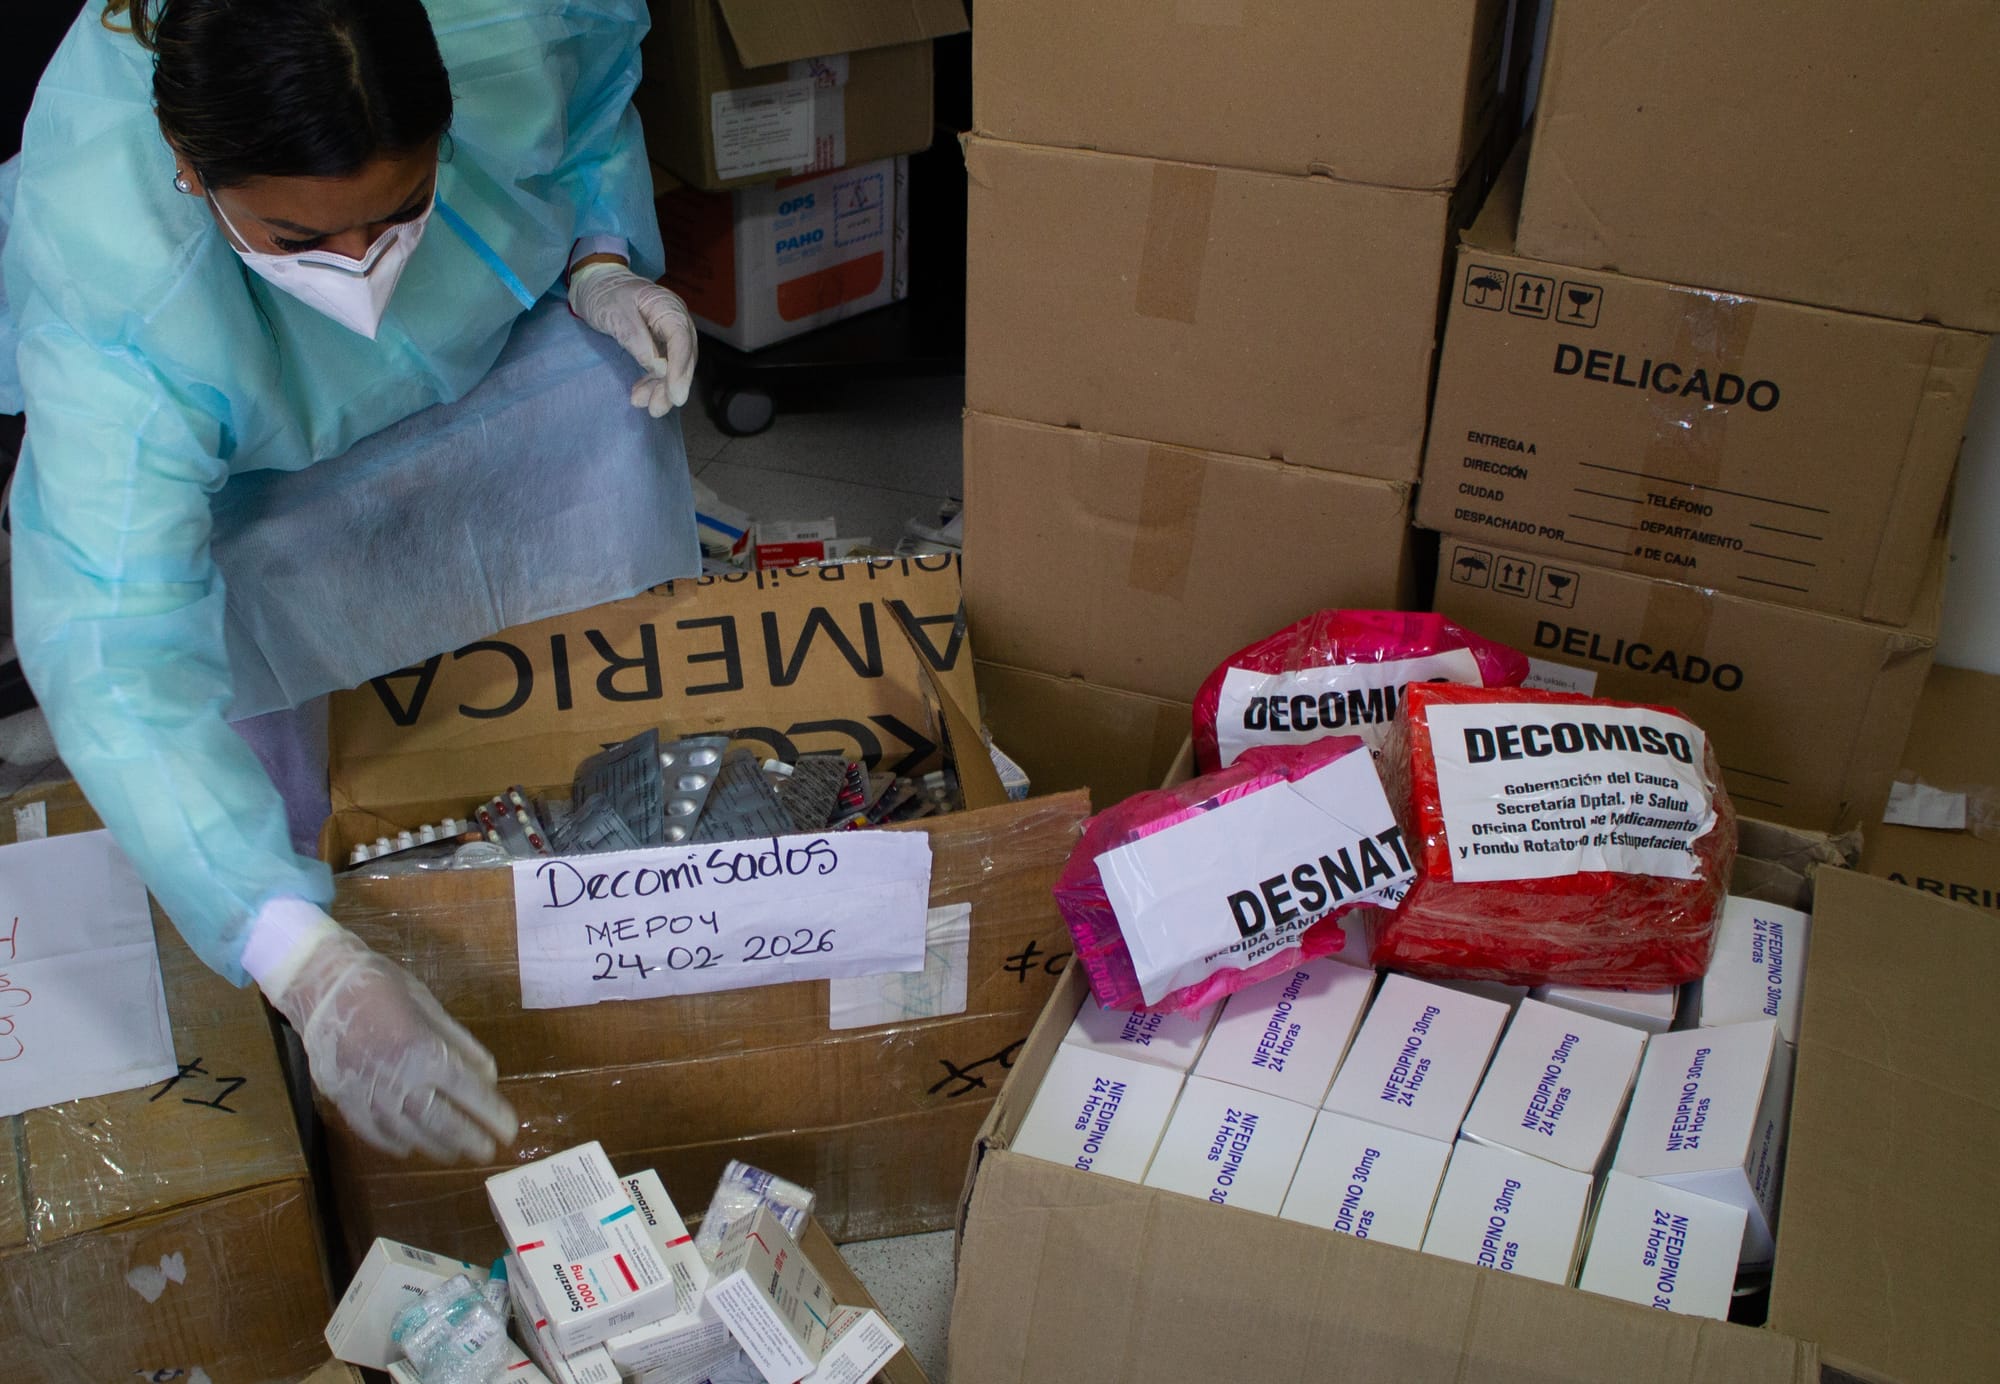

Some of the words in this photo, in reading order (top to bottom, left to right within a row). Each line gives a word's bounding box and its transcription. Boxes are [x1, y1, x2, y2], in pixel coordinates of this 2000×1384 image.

[779, 192, 815, 216] OPS
[775, 228, 824, 254] PAHO
[1554, 343, 1780, 412] DELICADO
[1467, 430, 1525, 454] ENTREGA
[1527, 443, 1537, 456] A
[1463, 457, 1528, 480] DIRECCIÓN
[1458, 483, 1504, 501] CIUDAD
[1646, 493, 1713, 518] TELÉFONO
[1455, 508, 1536, 535] DESPACHADO
[1538, 525, 1565, 542] POR
[1640, 520, 1744, 552] DEPARTAMENTO
[1644, 548, 1662, 562] DE
[1663, 551, 1698, 569] CAJA
[366, 598, 964, 726] AMERICA
[1534, 620, 1744, 693] DELICADO
[1464, 721, 1693, 764] DECOMISO
[1504, 774, 1602, 796] Gobernación
[1607, 771, 1631, 785] del
[1634, 771, 1679, 790] Cauca
[1497, 796, 1576, 816] Secretaría
[1580, 791, 1626, 810] Dptal.
[1648, 793, 1689, 812] Salud
[1531, 816, 1586, 833] Control
[1459, 845, 1469, 860] y
[536, 837, 838, 908] Decomisados
[1752, 918, 1768, 932] 24
[742, 928, 837, 963] 2026
[1752, 932, 1768, 965] Horas
[1767, 921, 1784, 985] NIFEDIPINO
[1764, 984, 1783, 1017] 30mg
[1250, 1000, 1294, 1068] NIFEDIPINO
[1283, 971, 1311, 1001] 30mg
[1135, 1031, 1152, 1047] 24
[1274, 1022, 1302, 1056] Horas
[1380, 1036, 1422, 1104] NIFEDIPINO
[1411, 1004, 1441, 1038] 30mg
[1267, 1056, 1284, 1074] 24
[1403, 1056, 1432, 1090] Horas
[1521, 1064, 1563, 1131] NIFEDIPINO
[1551, 1032, 1580, 1065] 30mg
[1092, 1077, 1110, 1093] 24
[1396, 1090, 1413, 1108] 24
[1543, 1085, 1572, 1118] Horas
[1665, 1080, 1699, 1153] NIFEDIPINO
[1686, 1047, 1712, 1082] 30mg
[1074, 1094, 1103, 1131] Horas
[1083, 1081, 1127, 1154] NIFEDIPINO
[1223, 1107, 1242, 1125] 24
[1537, 1120, 1554, 1138] 24
[1686, 1096, 1712, 1131] Horas
[1207, 1124, 1236, 1162] Horas
[1216, 1112, 1259, 1187] NIFEDIPINO
[1683, 1133, 1700, 1151] 24
[1351, 1147, 1381, 1183] 30mg
[626, 1178, 659, 1228] Somazina
[1493, 1178, 1521, 1214] 30mg
[1652, 1208, 1671, 1227] 24
[1642, 1226, 1667, 1268] Horas
[1656, 1214, 1690, 1294] NIFEDIPINO
[552, 1263, 584, 1313] Somazina
[570, 1264, 585, 1281] mg
[576, 1283, 599, 1309] 1000
